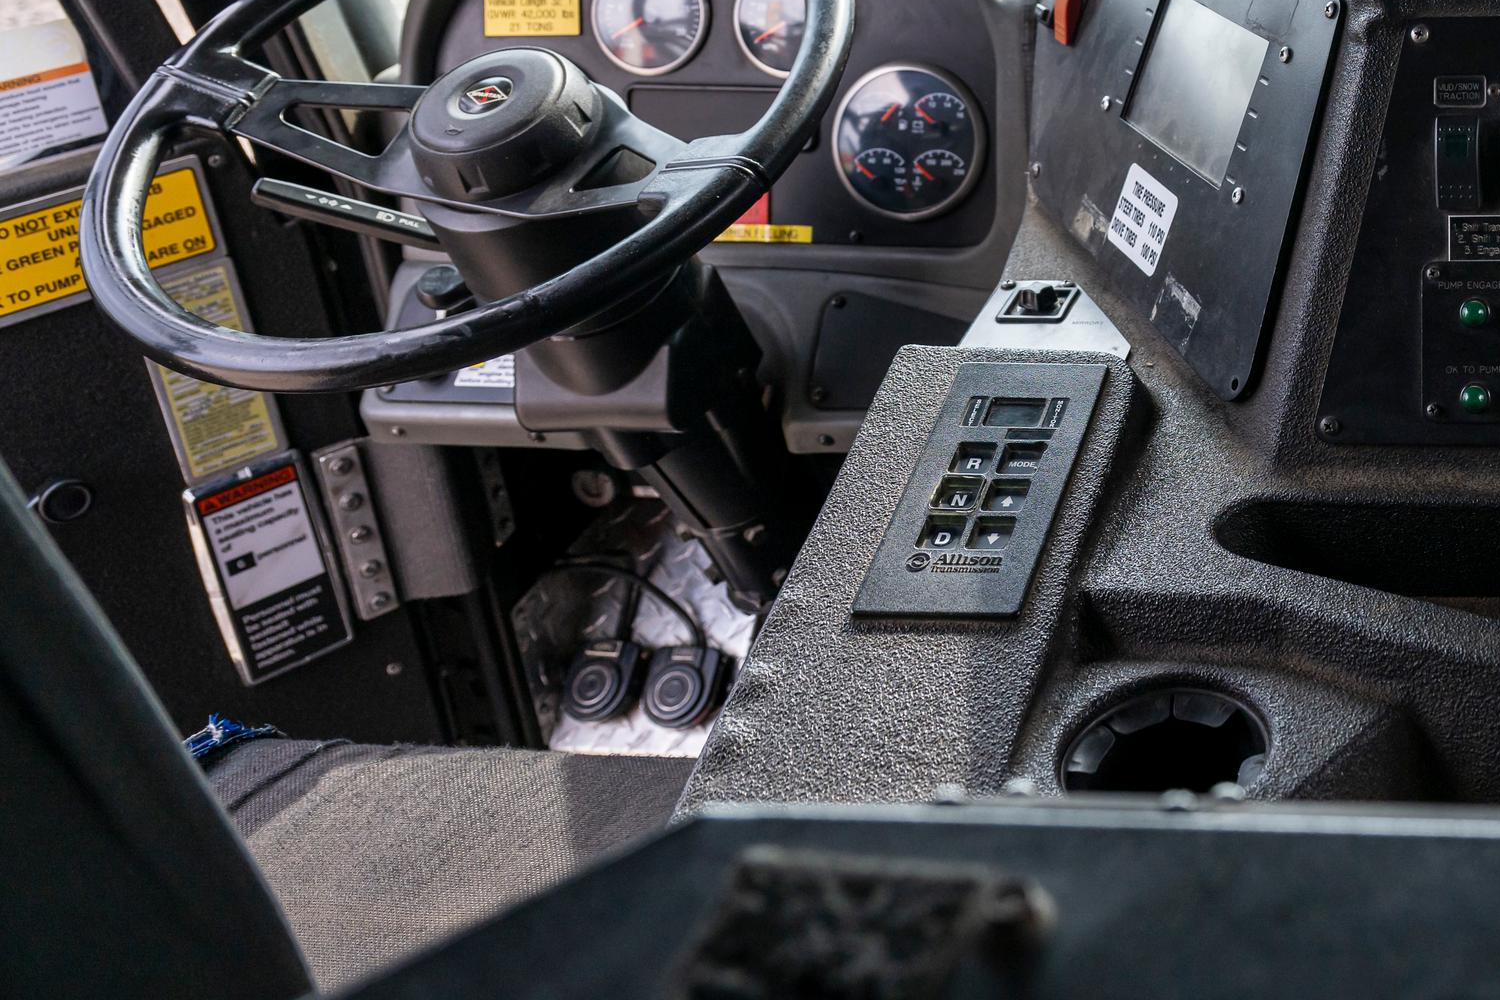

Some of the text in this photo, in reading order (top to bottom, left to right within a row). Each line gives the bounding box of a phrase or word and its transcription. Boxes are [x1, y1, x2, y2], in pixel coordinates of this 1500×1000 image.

[1438, 91, 1480, 100] TRACTION
[1133, 181, 1166, 217] TIRE PRESSURE
[14, 216, 50, 238] NOT
[52, 204, 83, 224] EXI
[399, 217, 419, 229] PULL
[1119, 196, 1165, 246] STEER TIRES 110 PSI
[6, 245, 65, 271] GREEN
[142, 205, 196, 231] GAGED
[47, 224, 80, 242] UNL
[1472, 234, 1489, 243] Shift
[1111, 216, 1126, 238] DRIVE
[1123, 226, 1138, 248] TIRES
[1148, 249, 1159, 267] PSI
[7, 289, 31, 305] TO
[34, 273, 81, 298] PUMP
[148, 242, 180, 261] ARE
[182, 235, 207, 254] ON
[1438, 281, 1463, 290] PUMP
[1445, 366, 1458, 375] OK
[1463, 365, 1476, 374] TO
[966, 457, 982, 470] R
[1008, 461, 1037, 469] MODE
[950, 495, 968, 507] N
[934, 532, 952, 545] D
[932, 553, 1003, 567] Allison
[930, 565, 1000, 574] Transmission
